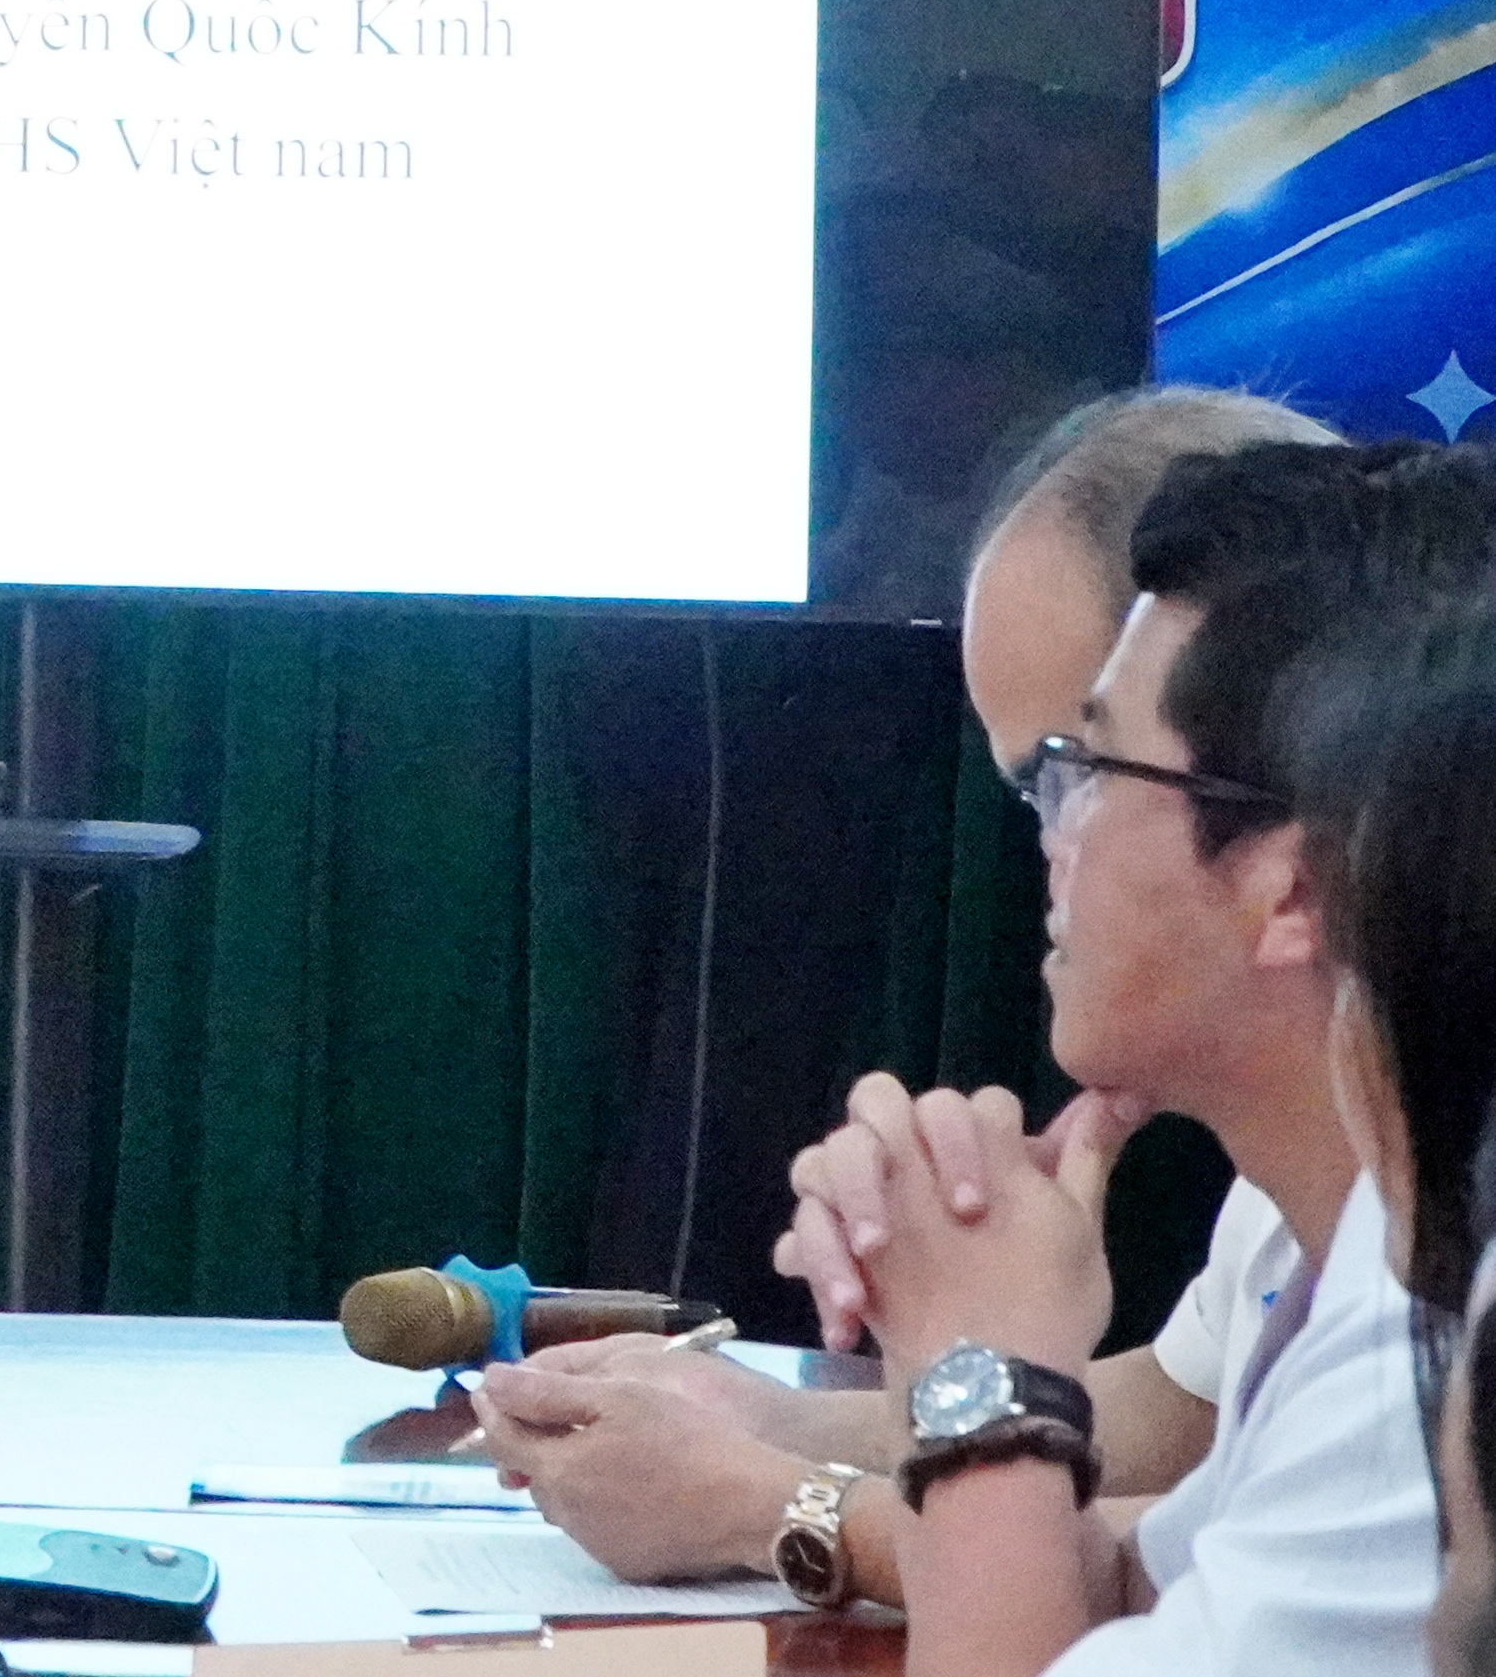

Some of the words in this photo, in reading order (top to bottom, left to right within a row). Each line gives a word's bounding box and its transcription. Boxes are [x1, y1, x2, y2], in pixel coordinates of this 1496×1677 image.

[352, 0, 514, 59] Kính
[112, 114, 246, 192] Việt
[274, 138, 414, 182] nam
